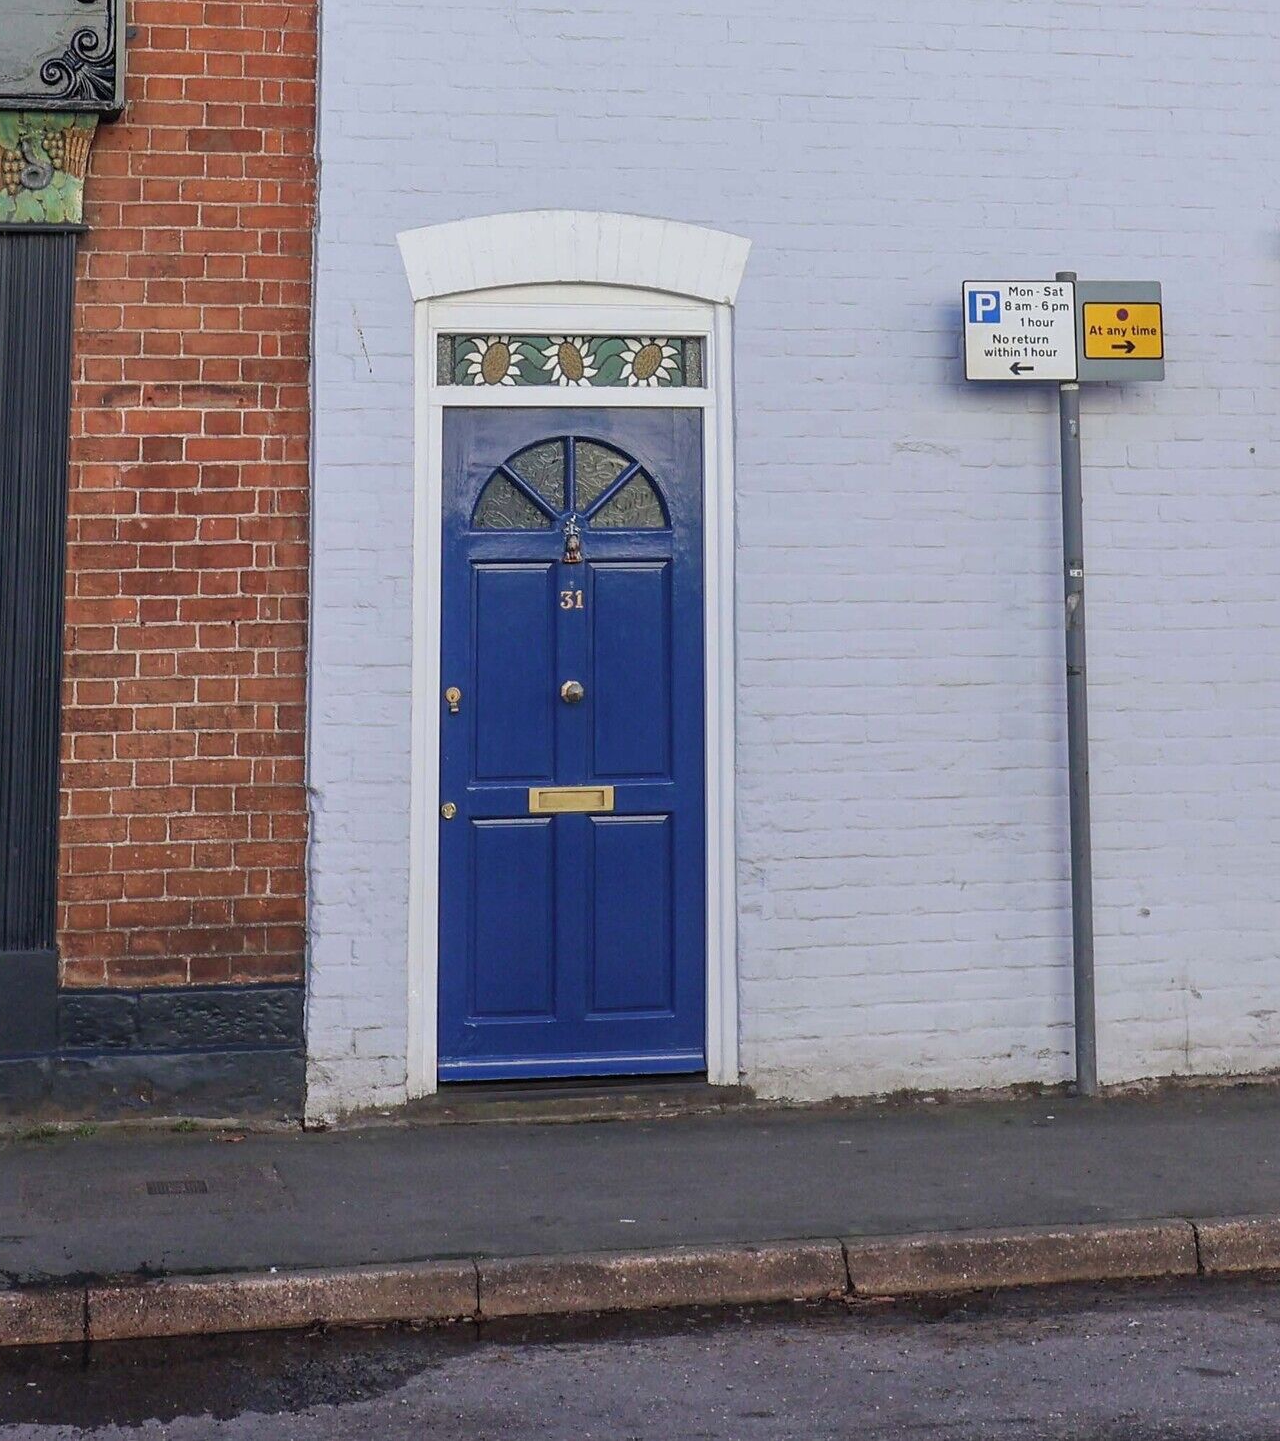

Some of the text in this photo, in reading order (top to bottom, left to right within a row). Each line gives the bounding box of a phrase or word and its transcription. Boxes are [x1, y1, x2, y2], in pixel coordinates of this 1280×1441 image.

[1008, 286, 1034, 297] Mon
[1043, 286, 1064, 297] Sat
[975, 293, 997, 322] P
[1004, 300, 1012, 311] 8
[1014, 303, 1032, 311] am
[1041, 300, 1049, 311] 6
[1051, 303, 1070, 313] pm
[1020, 317, 1055, 327] 1 hour
[1089, 325, 1157, 338] At any time
[992, 334, 1049, 345] No return
[984, 347, 1058, 357] within 1 hour
[560, 590, 584, 609] 31
